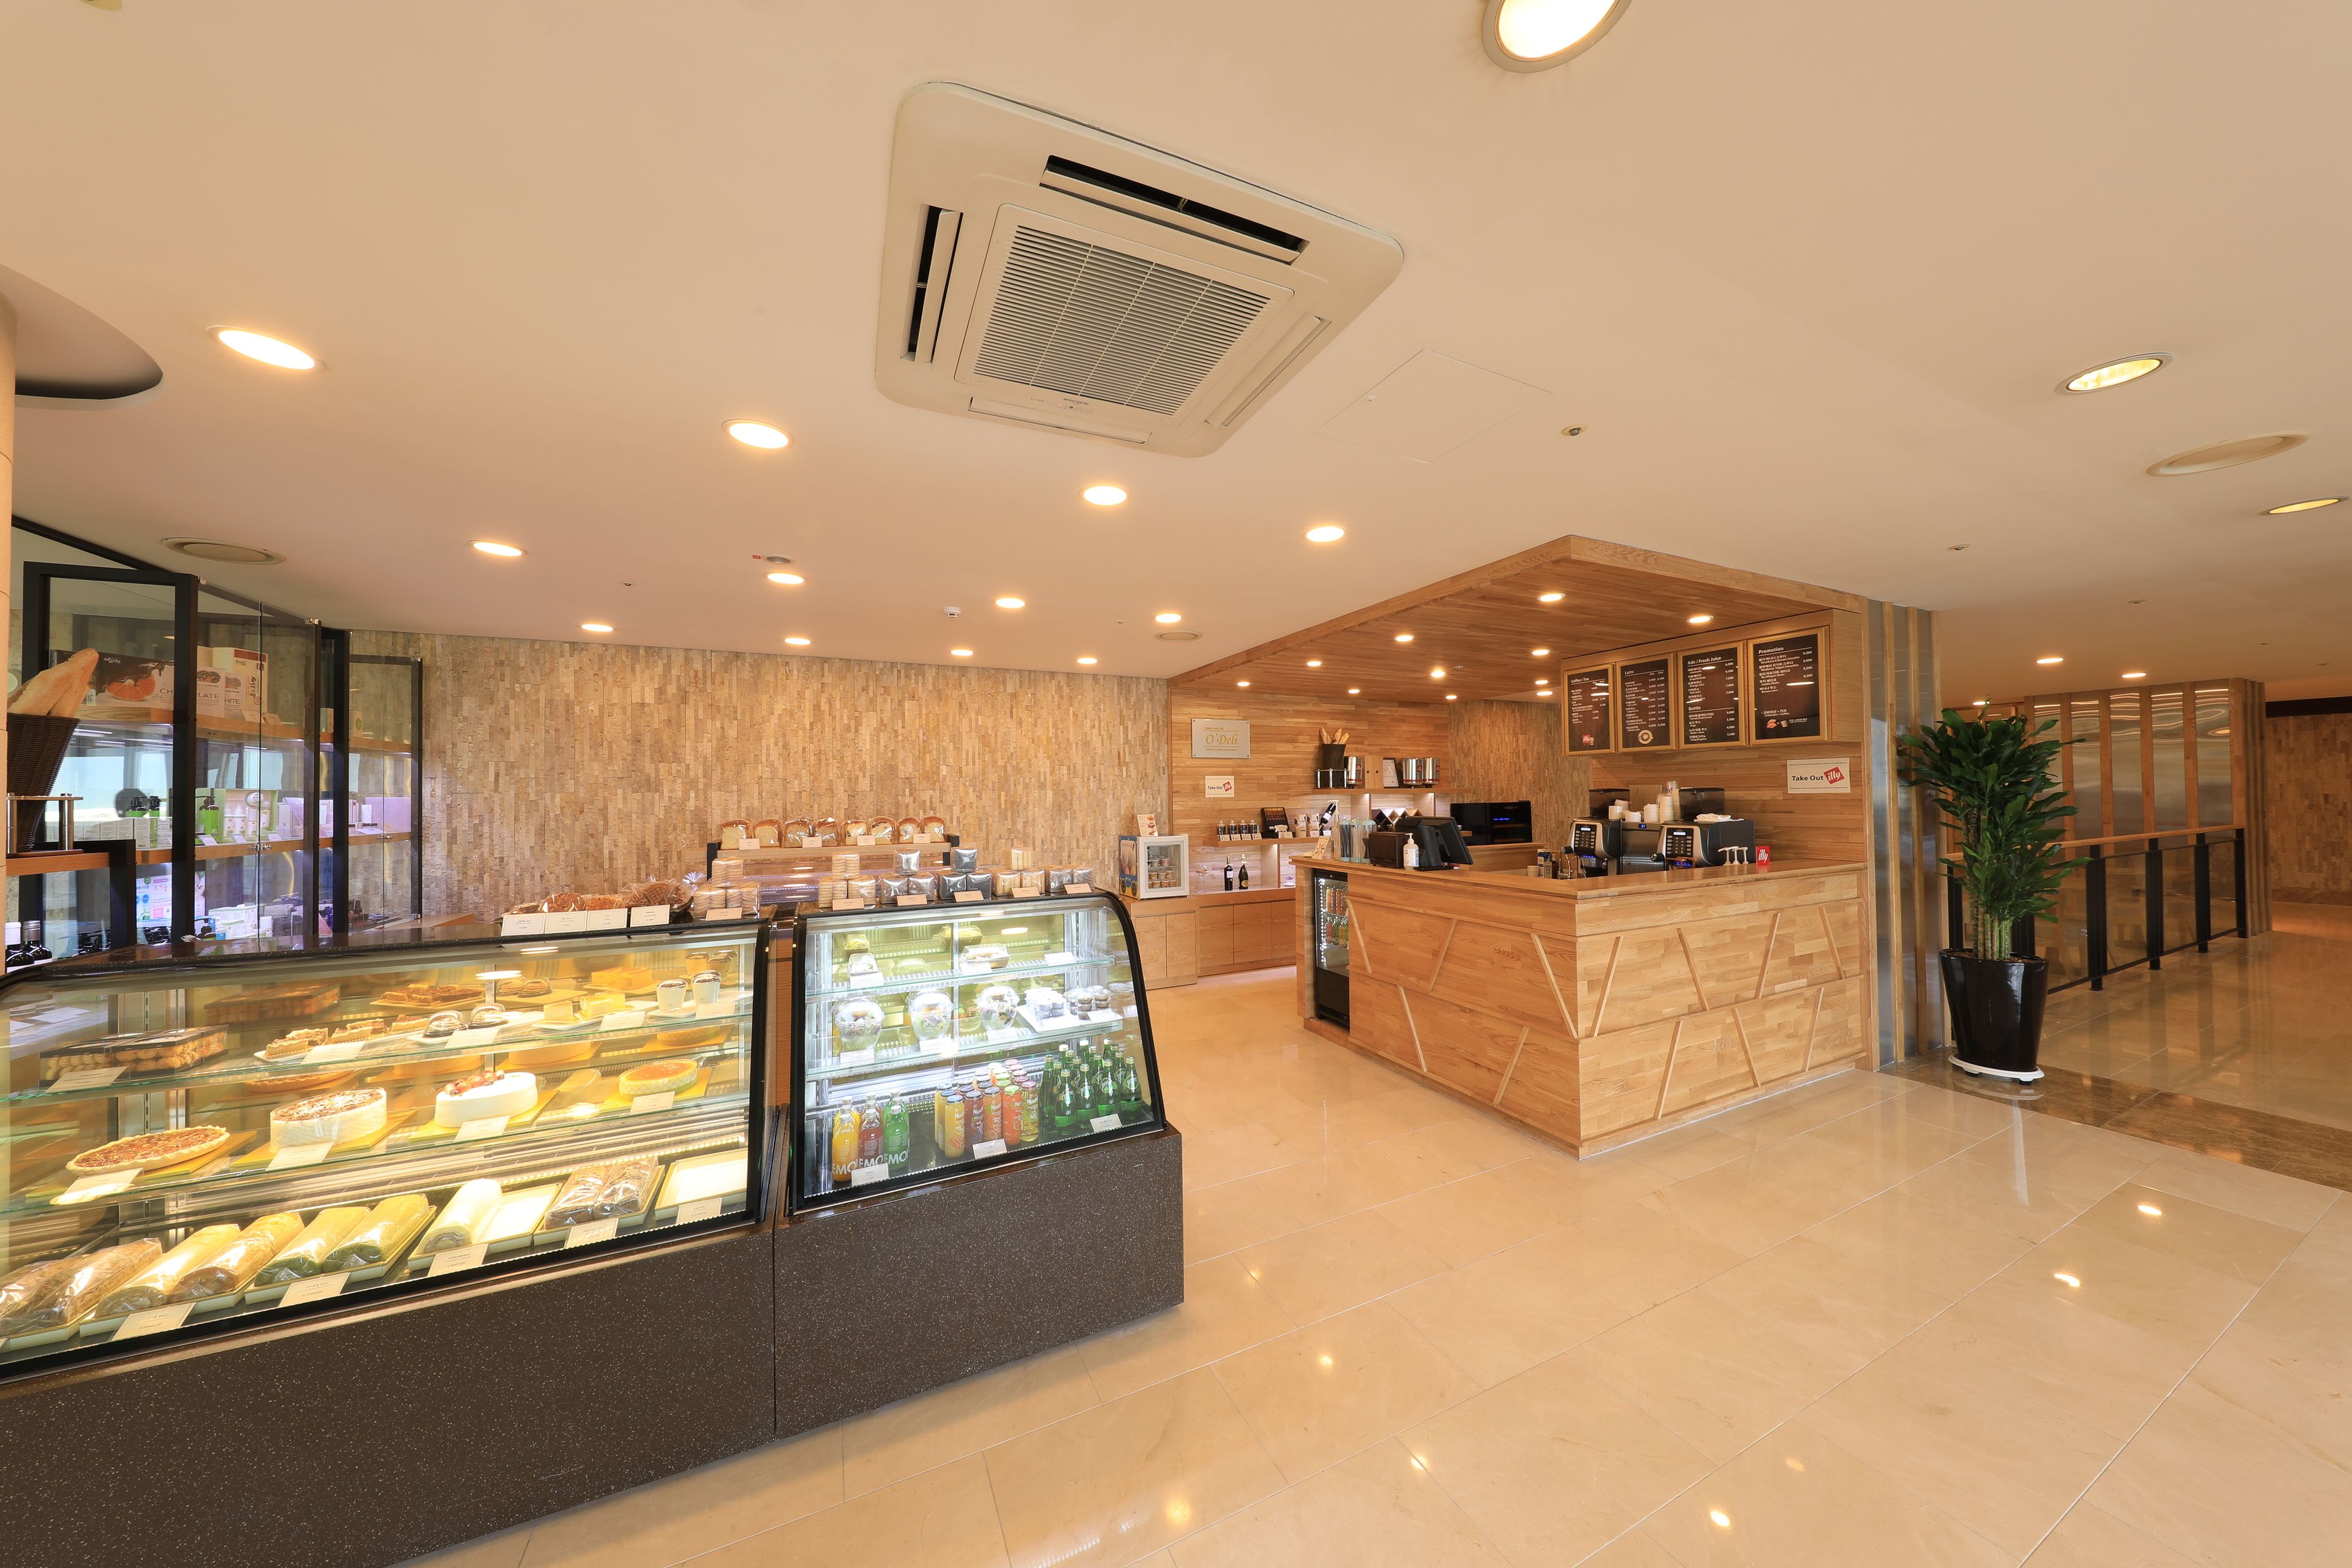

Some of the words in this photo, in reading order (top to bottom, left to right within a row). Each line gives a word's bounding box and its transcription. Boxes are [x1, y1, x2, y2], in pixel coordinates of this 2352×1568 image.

[1205, 733, 1238, 745] O'Deli
[1828, 771, 1841, 782] illy
[1758, 849, 1768, 864] illy
